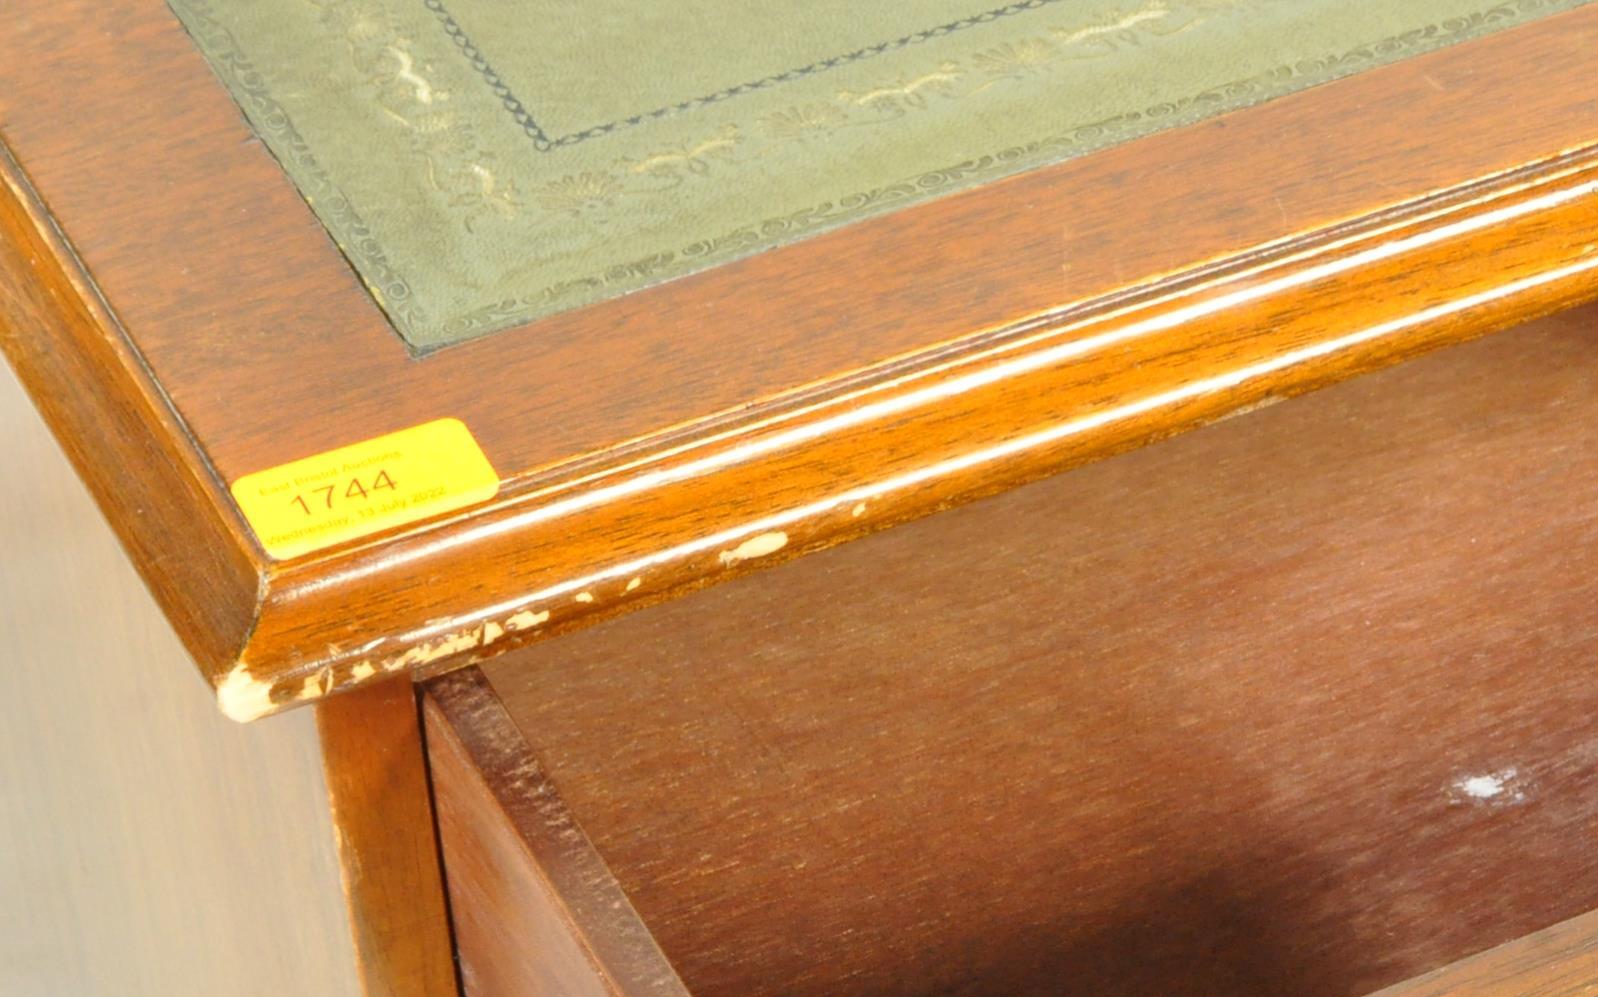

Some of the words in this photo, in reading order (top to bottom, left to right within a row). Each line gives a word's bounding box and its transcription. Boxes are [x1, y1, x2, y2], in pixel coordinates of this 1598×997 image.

[342, 450, 403, 473] Auctions
[290, 469, 399, 516] 1744
[379, 498, 407, 514] July
[411, 485, 447, 503] 2022
